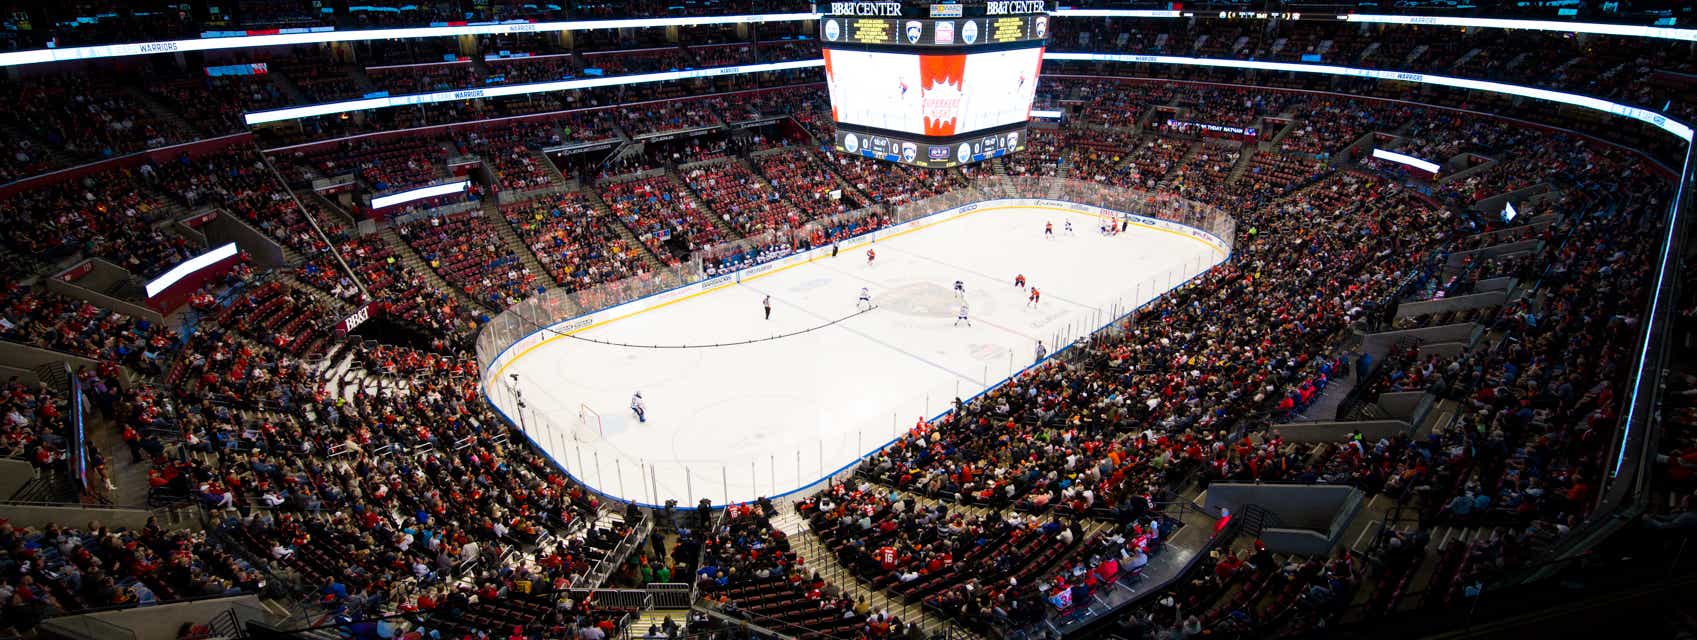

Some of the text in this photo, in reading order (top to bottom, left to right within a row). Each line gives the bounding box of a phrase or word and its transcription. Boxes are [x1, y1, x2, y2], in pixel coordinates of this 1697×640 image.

[831, 2, 902, 16] BB&T CENTER
[986, 0, 1045, 15] BB&T CENTER
[139, 42, 178, 53] WARRIORS
[454, 89, 484, 100] WARRIORS
[863, 139, 868, 149] 0
[893, 143, 899, 153] 0
[974, 143, 980, 153] 0
[1000, 137, 1005, 147] 0
[345, 306, 369, 333] BB&T
[885, 553, 894, 564] 16
